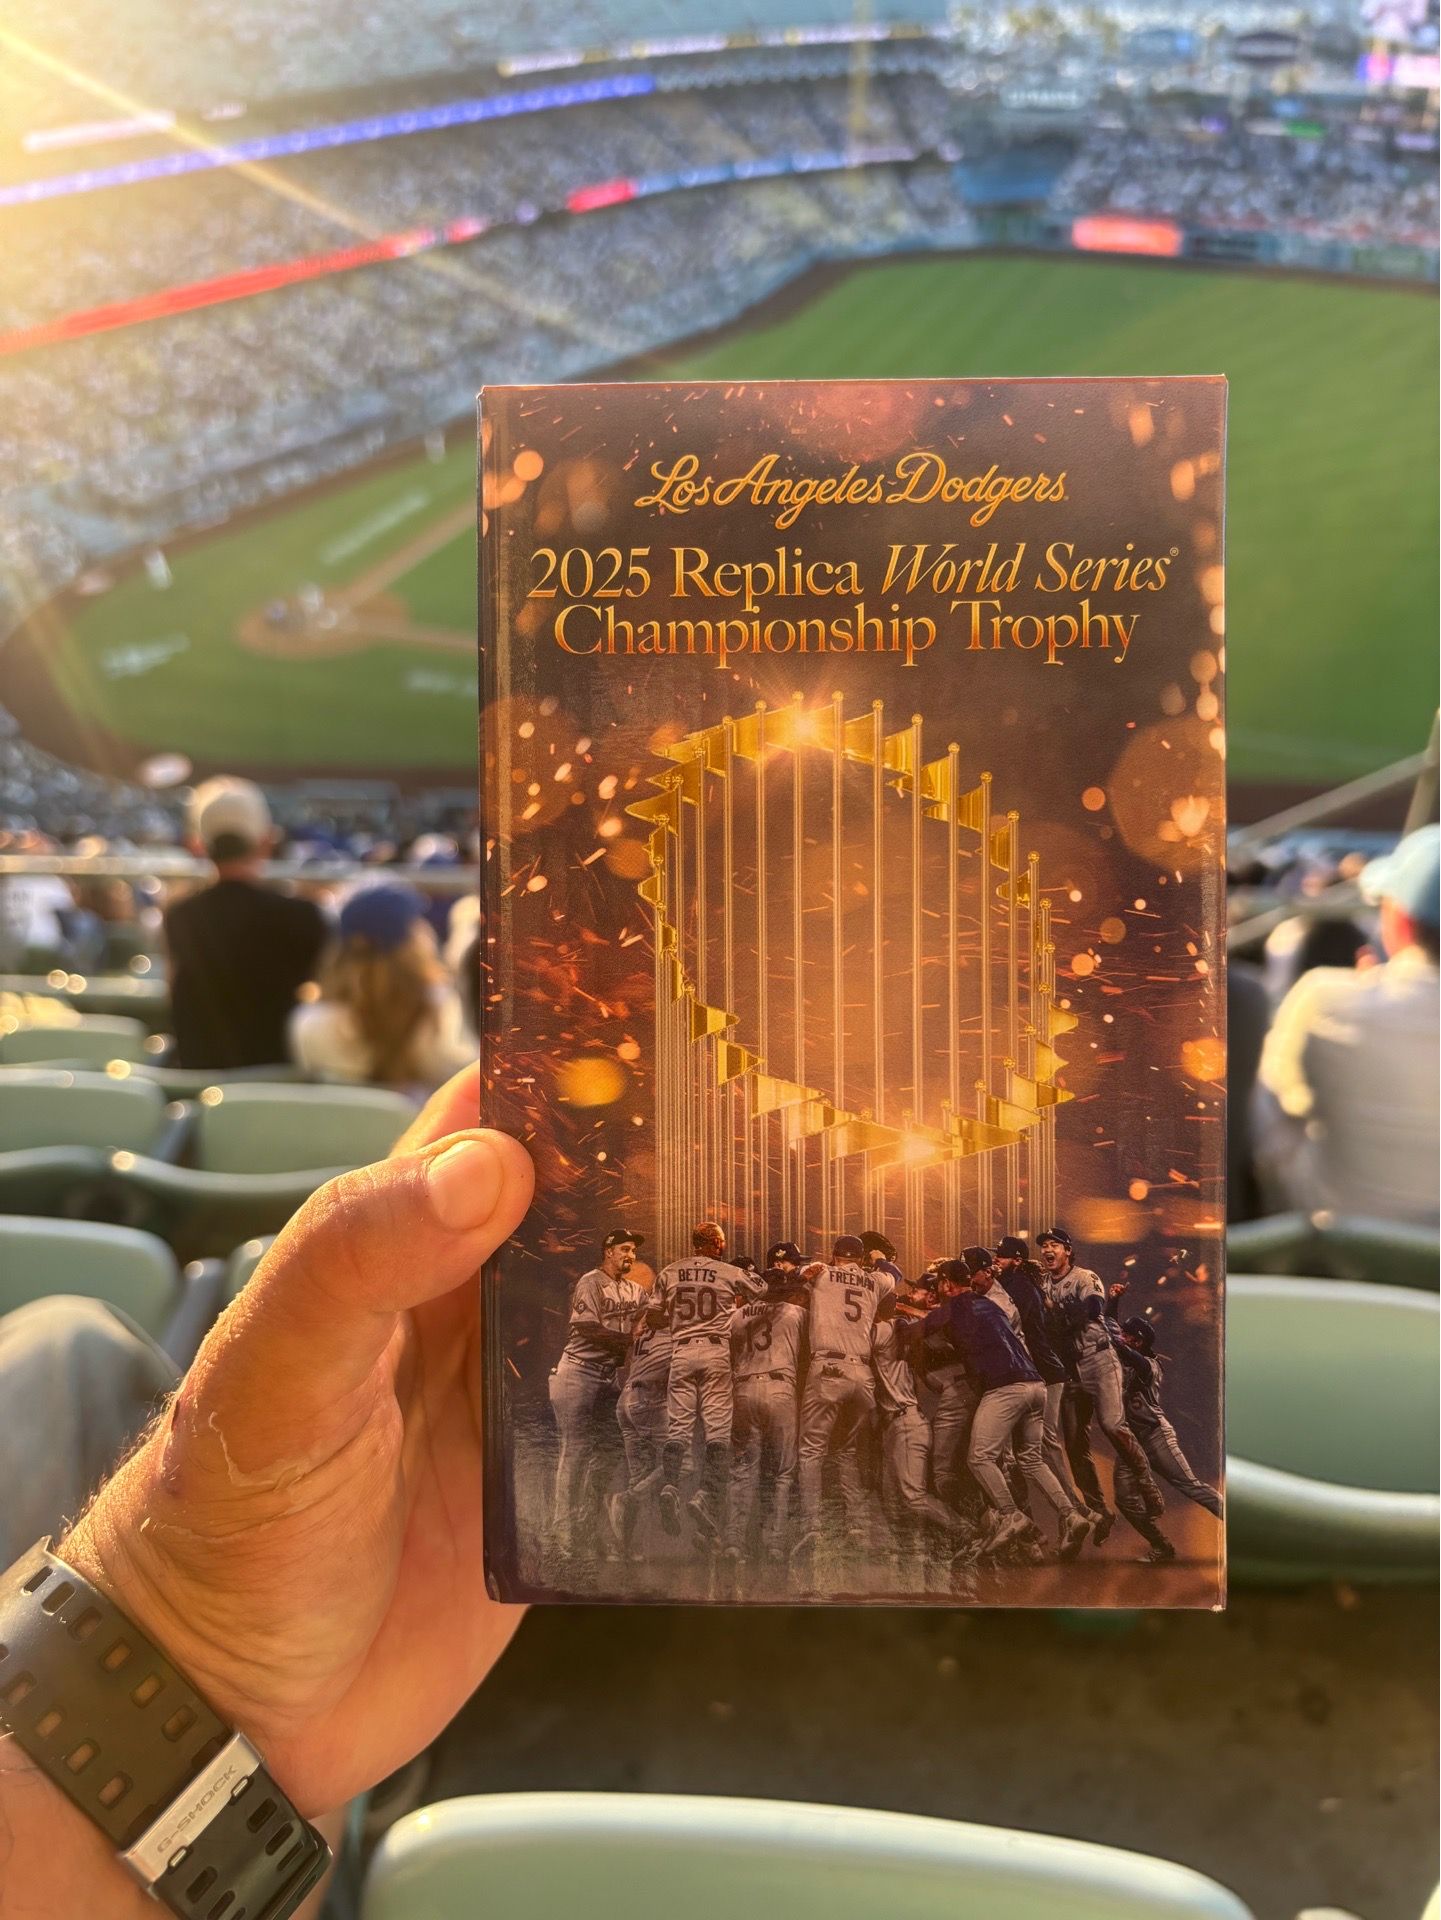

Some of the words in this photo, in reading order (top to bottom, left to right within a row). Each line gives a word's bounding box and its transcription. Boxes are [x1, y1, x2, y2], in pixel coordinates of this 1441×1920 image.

[634, 454, 714, 514] Los
[713, 453, 885, 530] Angeles
[885, 452, 1067, 527] Dodgers
[529, 547, 651, 598] 2025
[669, 546, 863, 613] Replica
[881, 543, 1026, 594] World
[554, 602, 937, 668] Championship
[950, 598, 1141, 665] Trophy
[678, 1268, 717, 1283] BETTS
[829, 1270, 875, 1293] FREEMAN
[675, 1286, 718, 1321] 50
[844, 1288, 863, 1323] 5
[156, 1765, 238, 1853] G-SHOCK
